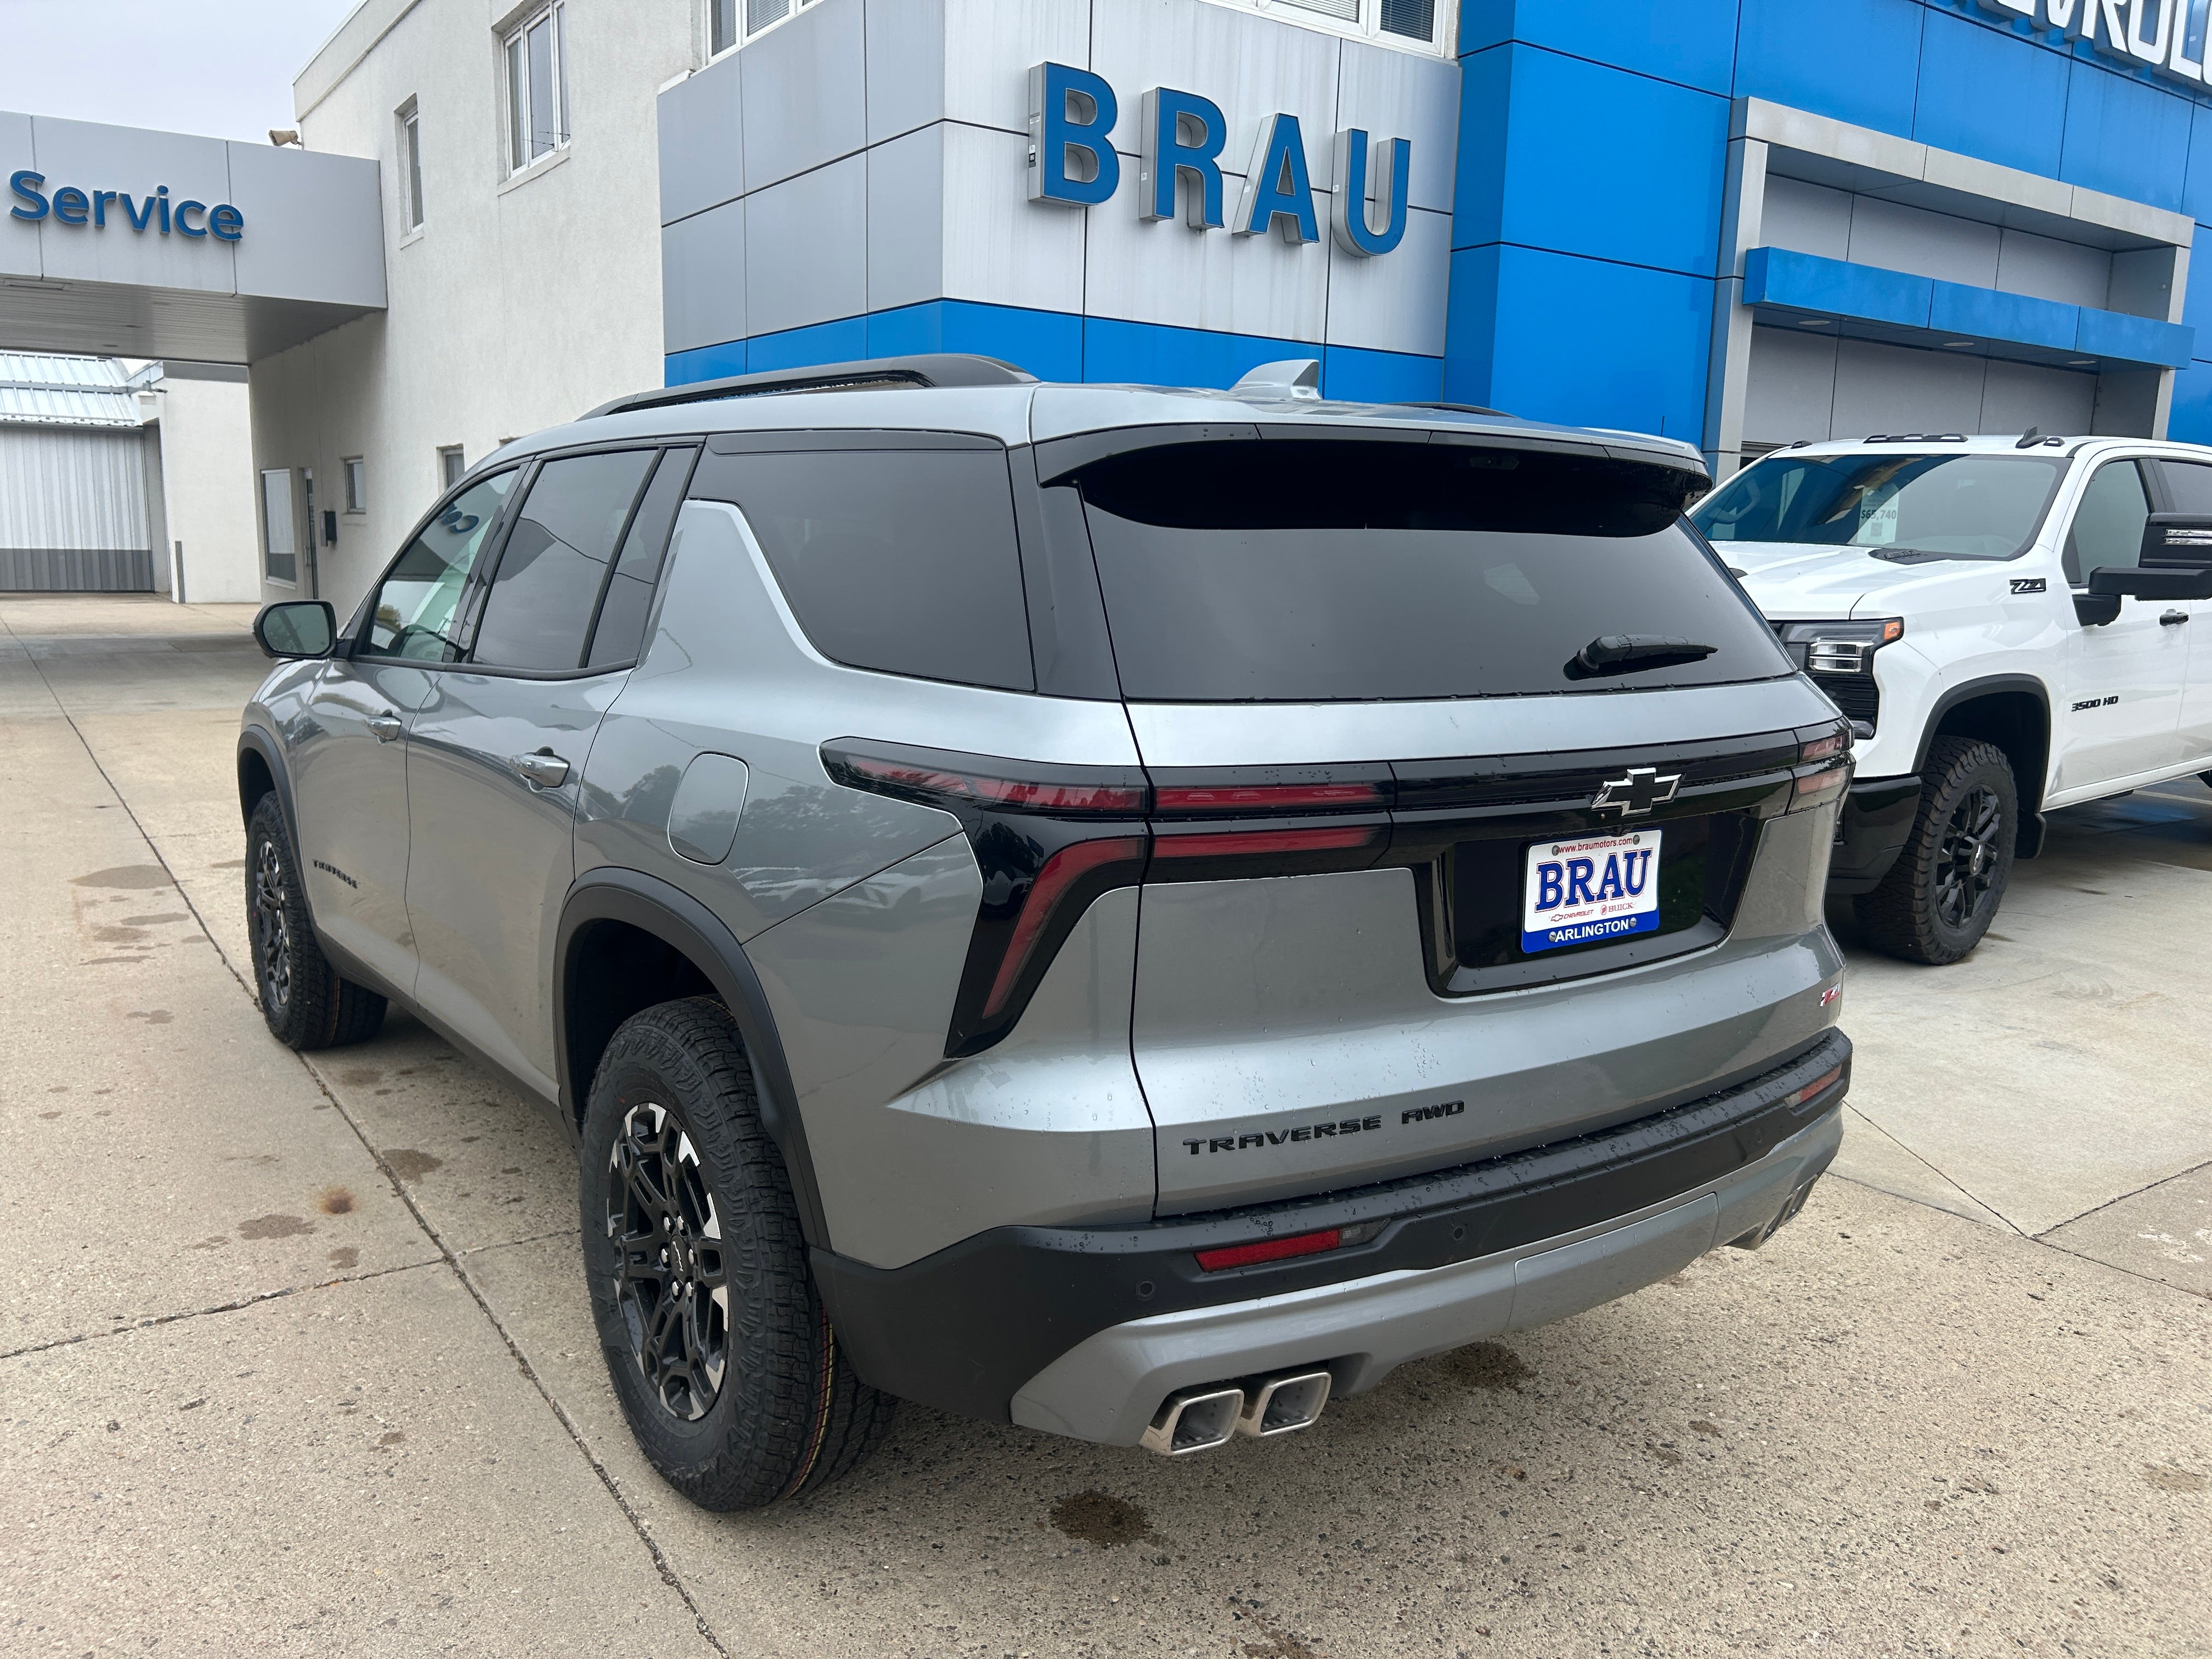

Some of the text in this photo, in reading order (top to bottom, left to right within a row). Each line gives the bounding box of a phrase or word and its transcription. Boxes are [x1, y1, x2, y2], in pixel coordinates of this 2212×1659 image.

[1029, 61, 1411, 258] BRAU
[10, 170, 244, 241] Service
[1860, 509, 1897, 520] $65,740
[2072, 696, 2119, 712] 3500 HD
[1558, 837, 1632, 854] www.braumotors.com
[1534, 848, 1652, 912] BRAU
[1564, 910, 1594, 919] CHEVROLET
[1609, 902, 1634, 912] BUICK
[1555, 918, 1628, 943] ARLINGTON
[1183, 1100, 1465, 1155] TRAVERSE AWD
